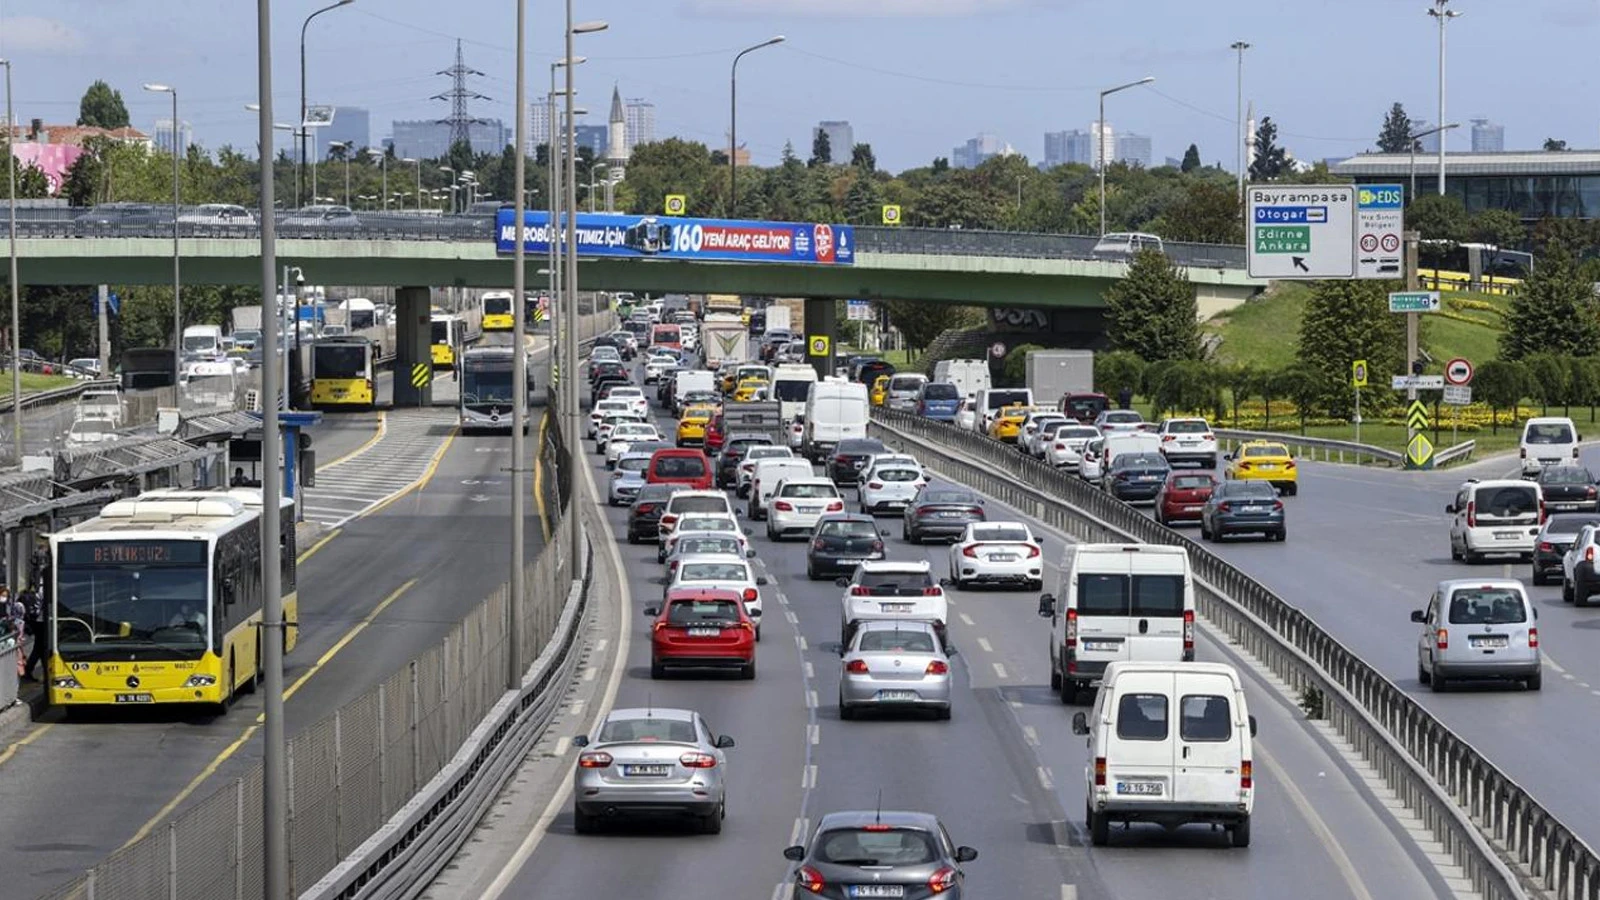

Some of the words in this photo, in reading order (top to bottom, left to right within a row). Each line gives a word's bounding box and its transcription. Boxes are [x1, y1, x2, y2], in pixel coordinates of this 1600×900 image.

[1377, 190, 1400, 203] EDS
[1257, 209, 1304, 220] Otogar
[604, 226, 626, 247] İÇİN
[673, 224, 703, 252] 160
[703, 229, 726, 246] YENİ
[725, 233, 751, 250] ARAÇ
[752, 231, 790, 249] GELİYOR
[1258, 229, 1303, 239] Edirne
[1259, 241, 1308, 250] Ankara
